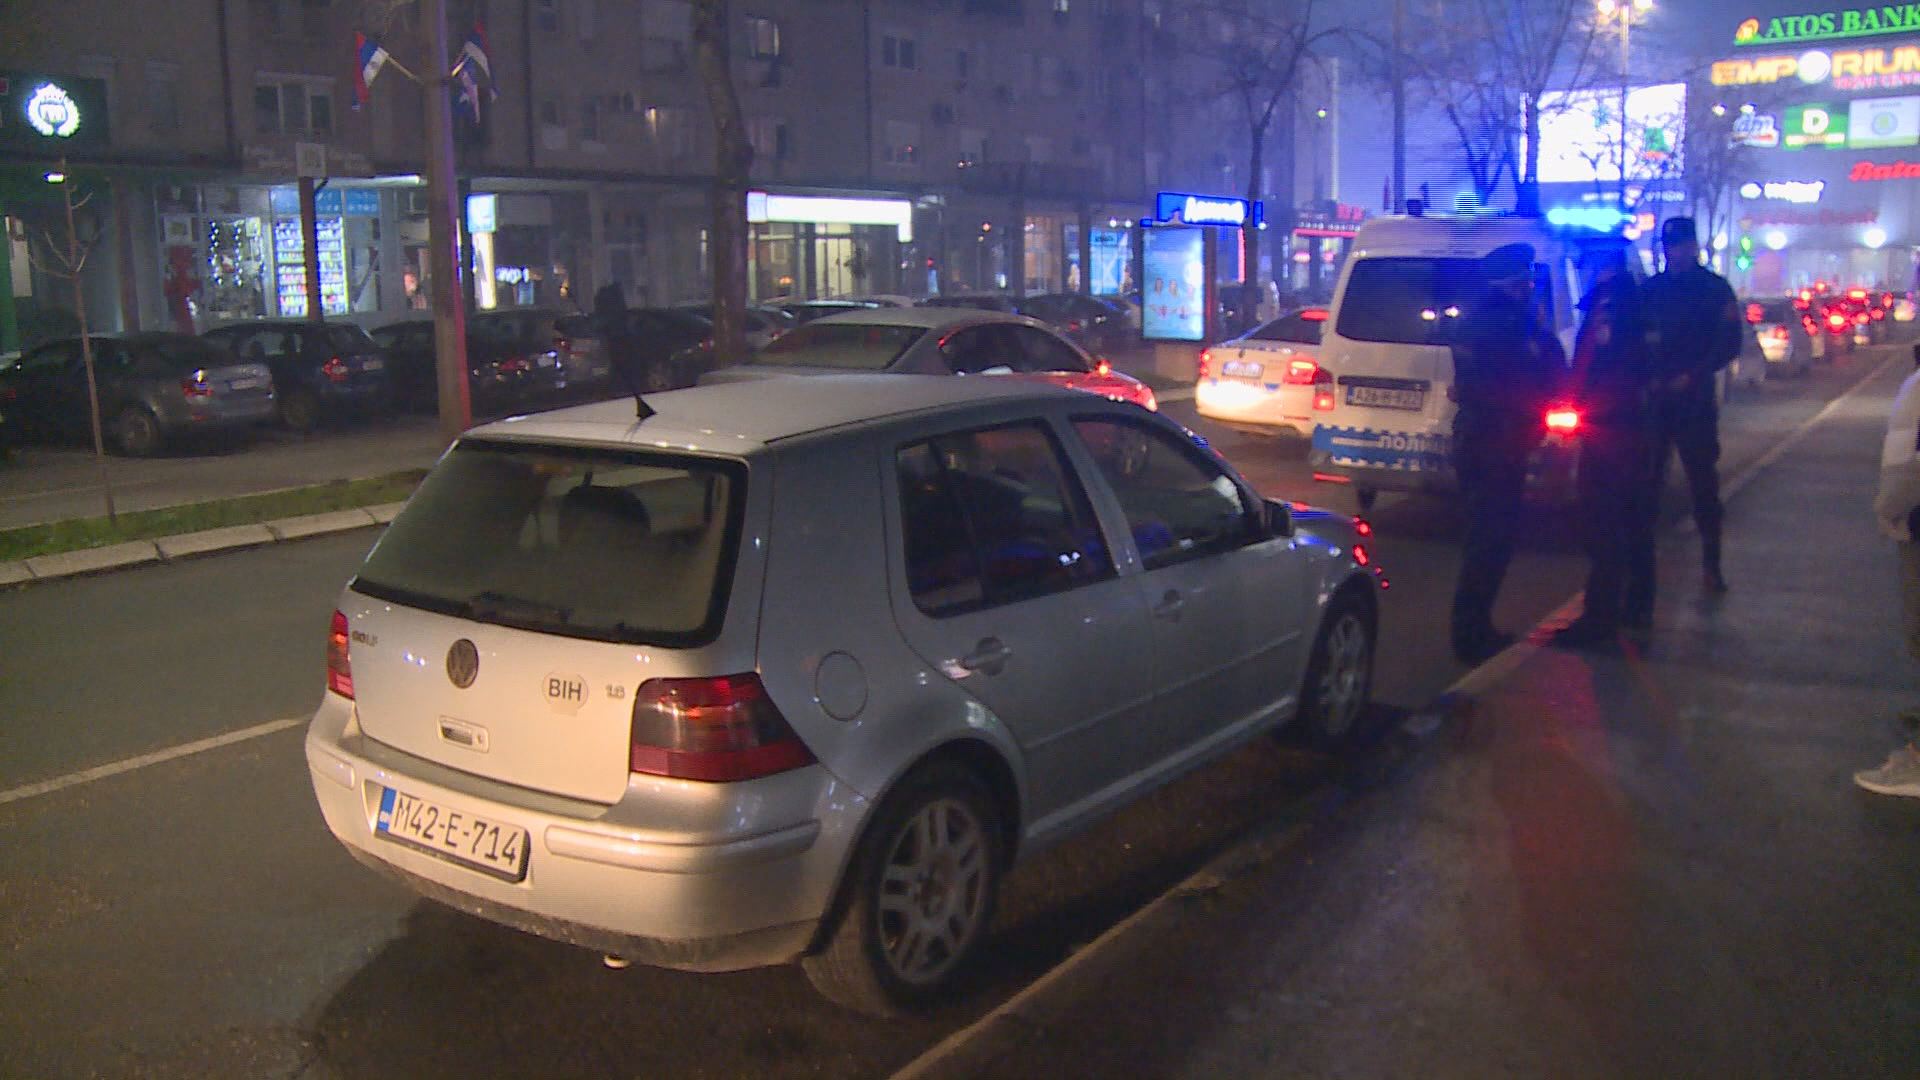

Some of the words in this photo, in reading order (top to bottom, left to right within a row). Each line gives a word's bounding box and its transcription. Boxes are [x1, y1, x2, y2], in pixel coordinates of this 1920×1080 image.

[1766, 13, 1836, 39] ATOS
[1842, 4, 1920, 32] BANK
[548, 678, 582, 702] BIH
[394, 796, 518, 866] M42-E-714
